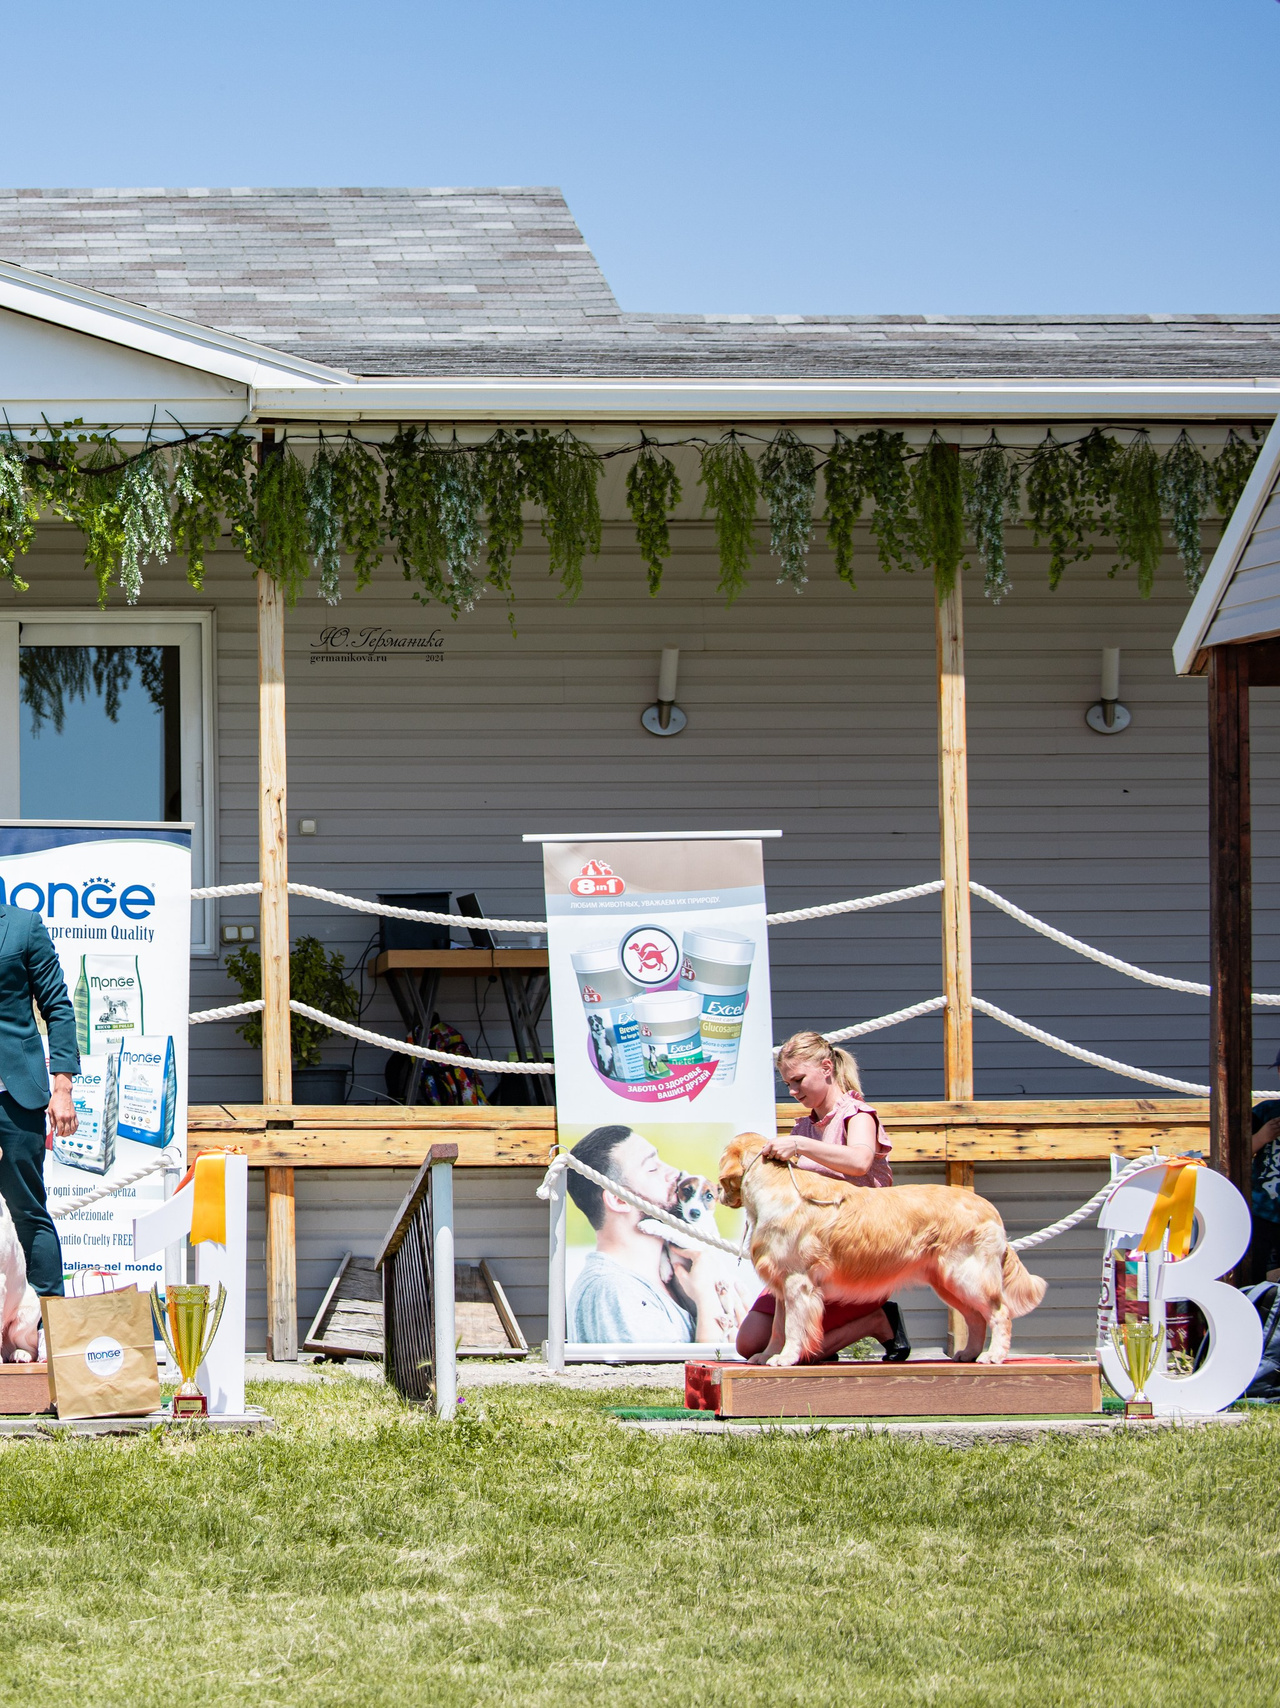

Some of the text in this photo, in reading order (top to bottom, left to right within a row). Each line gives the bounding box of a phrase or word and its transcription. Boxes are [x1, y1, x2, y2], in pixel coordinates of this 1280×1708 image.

[577, 878, 617, 895] 8in1
[598, 900, 641, 909] ЖИВОТНЫХ,
[641, 899, 676, 907] УВАЖАЕМ
[111, 925, 155, 943] Quality
[707, 1001, 744, 1015] Excel
[619, 1025, 639, 1034] Brewe
[627, 1085, 657, 1093] ЗАБОТА
[658, 1083, 664, 1091] О
[665, 1066, 703, 1089] ЗДОРОВЬЕ
[657, 1069, 711, 1099] ВАШИХ ДРУЗЕЙ
[53, 1185, 70, 1197] ogni
[69, 1209, 114, 1221] Selezionate
[60, 1233, 134, 1247] antito Cruelty FREE
[63, 1261, 163, 1272] taliano nel mondo
[1096, 1163, 1264, 1413] 3
